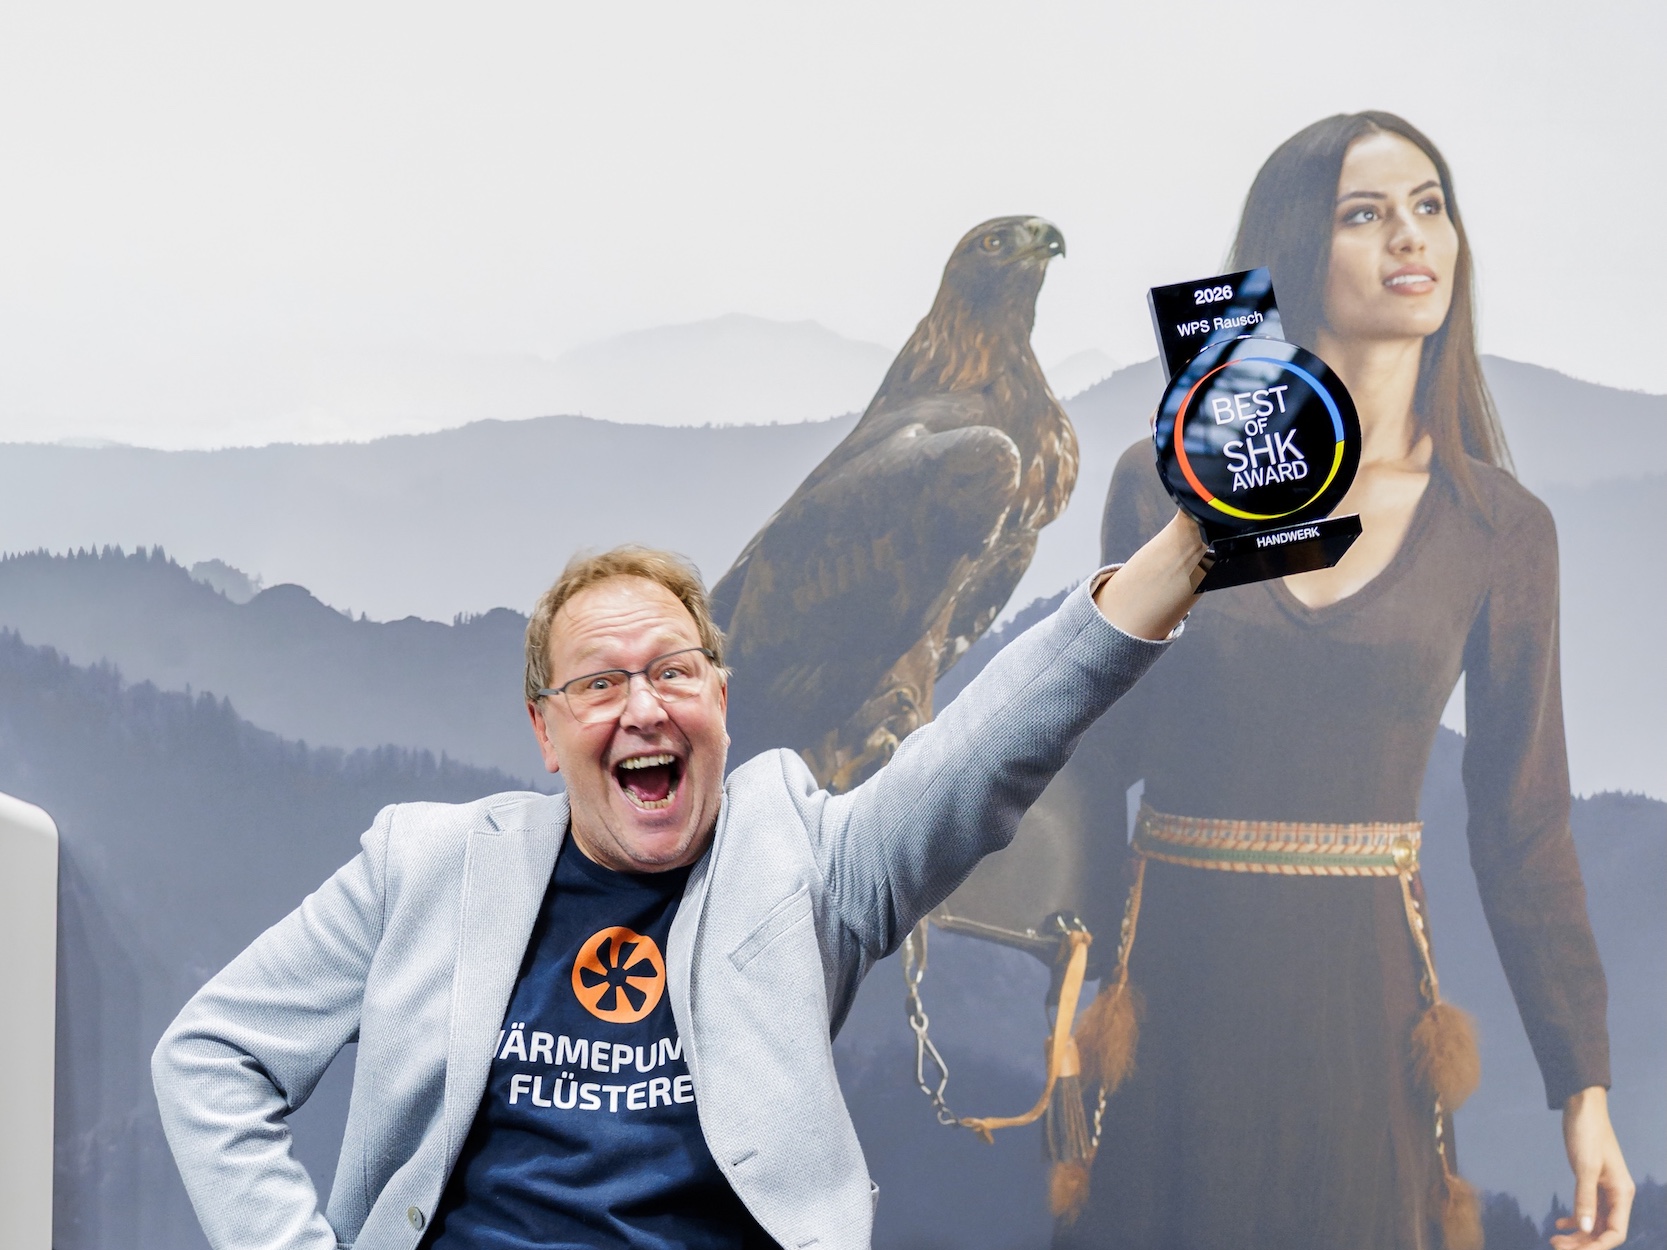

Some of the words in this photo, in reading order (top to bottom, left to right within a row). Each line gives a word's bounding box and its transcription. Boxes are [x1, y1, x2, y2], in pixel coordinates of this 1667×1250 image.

[1194, 285, 1233, 305] 2026
[1177, 319, 1211, 338] WPS
[1214, 311, 1263, 331] Rausch
[1212, 386, 1288, 426] BEST
[1244, 416, 1268, 437] OF
[1222, 428, 1305, 473] SHK
[1231, 460, 1308, 492] AWARD
[1256, 526, 1320, 548] HANDWERK
[493, 1022, 688, 1073] ÄRMEPUM
[509, 1071, 694, 1113] FLÜSTERE
